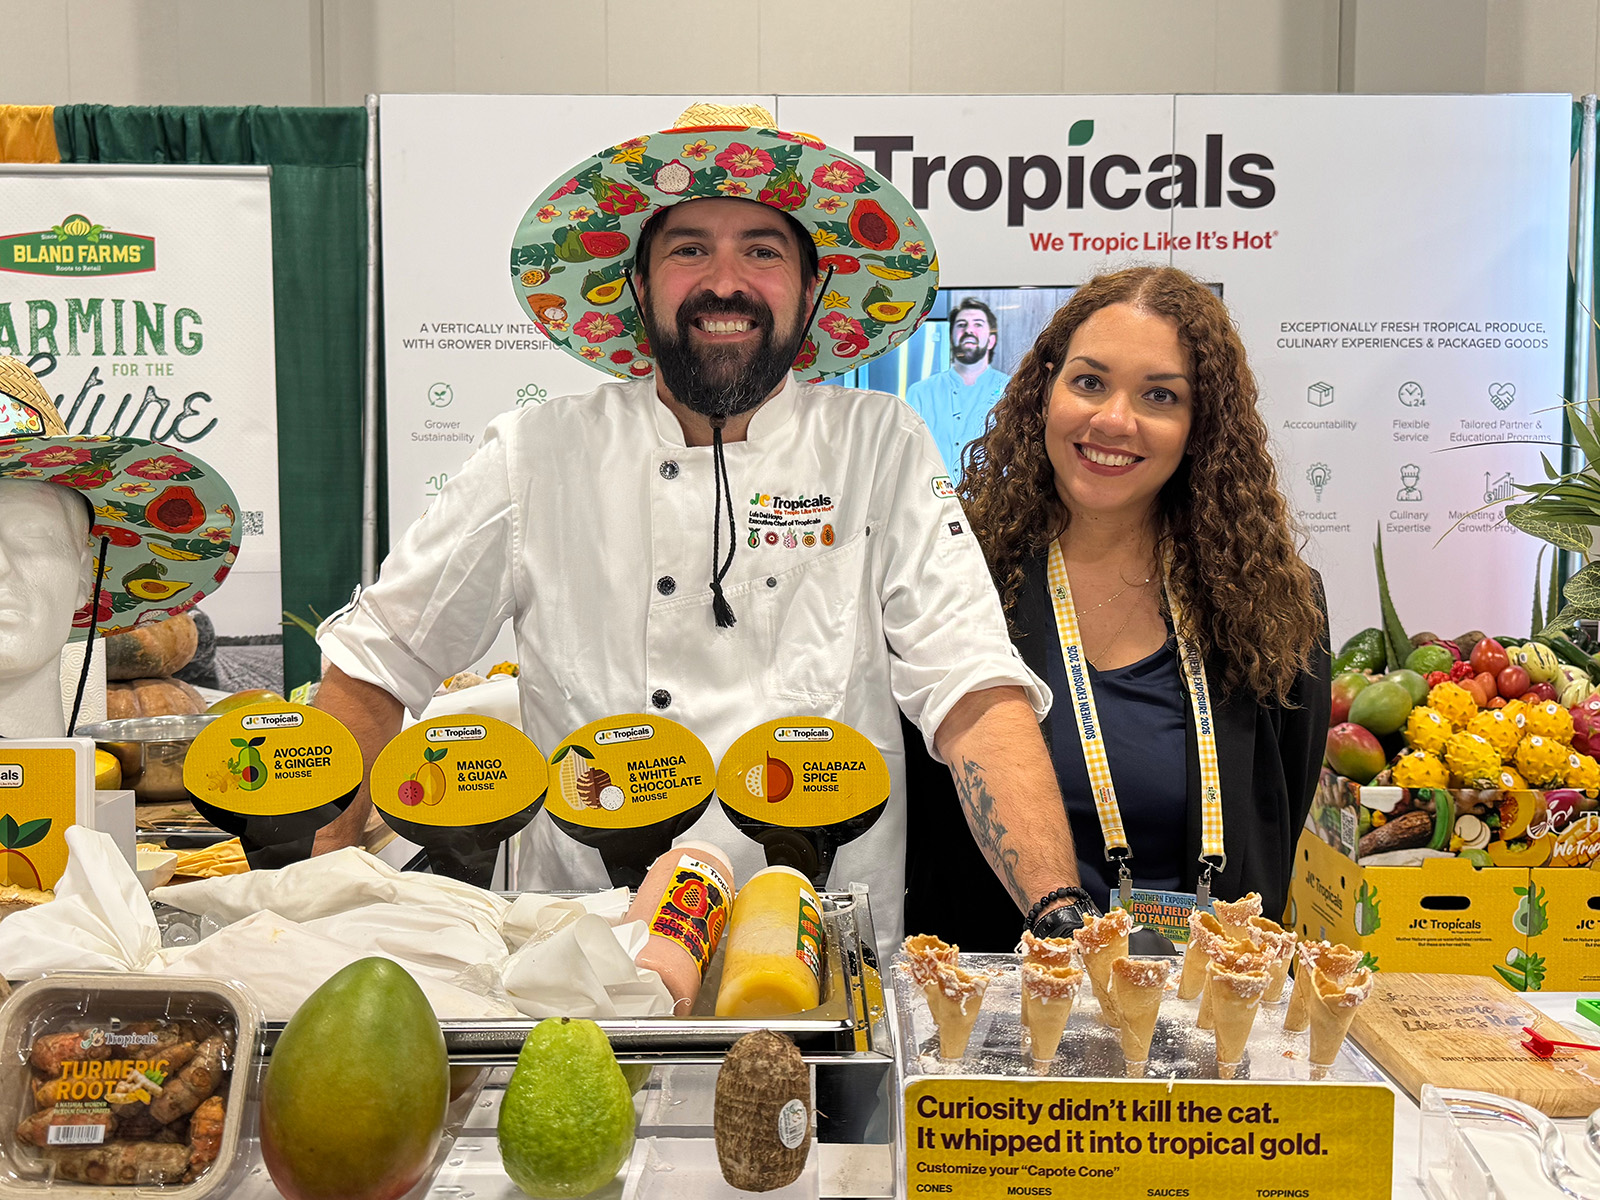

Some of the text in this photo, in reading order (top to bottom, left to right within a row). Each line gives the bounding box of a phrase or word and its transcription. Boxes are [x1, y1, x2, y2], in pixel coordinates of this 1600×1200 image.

[854, 119, 1276, 227] Tropicals
[1029, 231, 1064, 251] We
[1068, 231, 1139, 255] Tropic
[1143, 230, 1191, 251] Like
[1196, 230, 1228, 250] It’s
[13, 245, 74, 263] BLAND
[0, 297, 204, 356] ARMING
[419, 324, 428, 334] A
[431, 323, 504, 334] VERTICALLY
[1280, 322, 1546, 334] EXCEPTIONALLY FRESH TROPICAL PRODUCE,
[402, 339, 435, 349] WITH
[438, 339, 492, 350] GROWER
[1276, 337, 1549, 349] CULINARY EXPERIENCES & PACKAGED GOODS
[112, 363, 174, 376] FOR THE
[424, 419, 461, 429] Grower
[1392, 420, 1430, 430] Flexible
[1460, 420, 1543, 430] Tailored Partner &
[411, 432, 475, 443] Sustainability
[1393, 432, 1429, 442] Service
[1450, 432, 1551, 442] Educational Programs
[749, 493, 832, 511] JC Tropicals
[1299, 511, 1337, 520] Product
[1389, 510, 1429, 523] Culinary
[1448, 511, 1504, 522] Marketing &
[794, 518, 821, 526] Tropicals
[1458, 523, 1491, 533] Growth
[1386, 523, 1431, 534] Expertise
[1068, 645, 1097, 741] SOUTHERN EXPOSURE 2026
[1193, 677, 1211, 735] EXPOSURE 2026
[246, 714, 299, 725] JC Tropicals
[430, 727, 482, 738] JC Tropicals
[598, 731, 612, 740] JC
[612, 727, 650, 739] Tropicals
[778, 728, 829, 738] JC Tropicals
[273, 745, 333, 759] AVOCADO
[274, 757, 331, 769] & GINGER
[457, 759, 502, 771] MANGO
[626, 755, 687, 772] MALANGA
[802, 761, 867, 771] CALABAZA
[0, 769, 19, 780] als
[274, 770, 313, 780] MOUSSE
[457, 770, 508, 782] & GUAVA
[628, 768, 678, 782] & WHITE
[802, 772, 838, 782] SPICE
[457, 783, 495, 792] MOUSSE
[630, 775, 703, 794] CHOCOLATE
[802, 784, 840, 792] MOUSSE
[631, 792, 668, 804] MOUSSE
[1553, 840, 1600, 858] We Trop
[1133, 893, 1195, 906] SOUTHERN EXPOSURE
[1315, 876, 1343, 911] Tropicals
[1134, 903, 1162, 914] FROM
[660, 908, 704, 940] Papaya
[1134, 913, 1190, 928] TO FAMILIE
[1408, 918, 1481, 931] JC Tropicals
[1576, 919, 1595, 930] JC
[652, 924, 694, 950] Sauce
[1392, 1006, 1431, 1018] We
[1402, 1020, 1452, 1032] Like
[1484, 1014, 1526, 1028] Hot
[104, 1031, 158, 1048] Tropicals
[60, 1059, 170, 1080] TURMERIC
[56, 1080, 118, 1100] ROOT
[916, 1094, 1280, 1125] Curiosity didn’t kill the cat.
[916, 1127, 1329, 1160] It whipped it into tropical gold.
[916, 1162, 1120, 1179] Customize your “Capote Cone”
[916, 1183, 1310, 1198] CONES MOUSES SAUCES TOPPINGS
